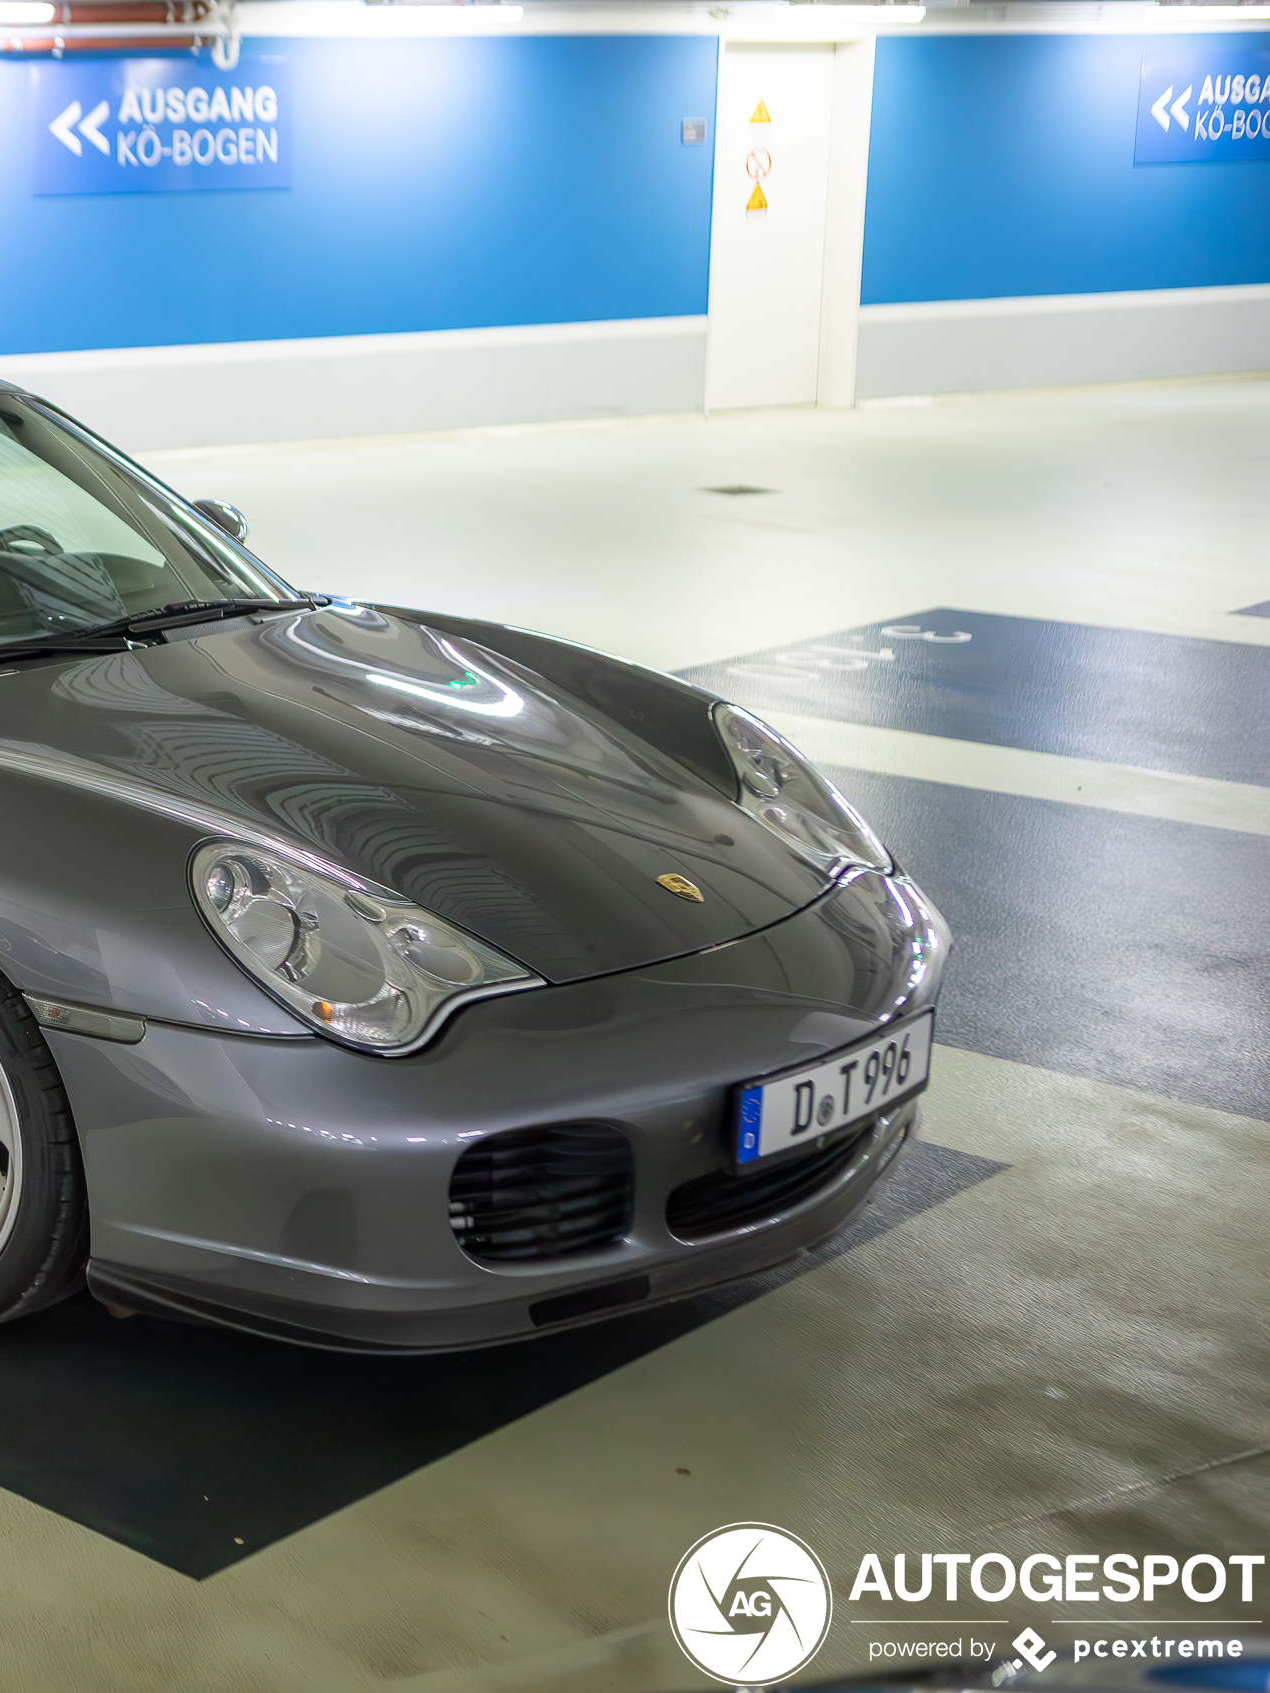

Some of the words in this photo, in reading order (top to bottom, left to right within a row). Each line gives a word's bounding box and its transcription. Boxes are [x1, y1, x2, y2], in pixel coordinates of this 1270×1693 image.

[117, 85, 278, 125] AUSGANG
[116, 123, 279, 168] KÖ-BOGEN
[789, 1078, 814, 1136] D
